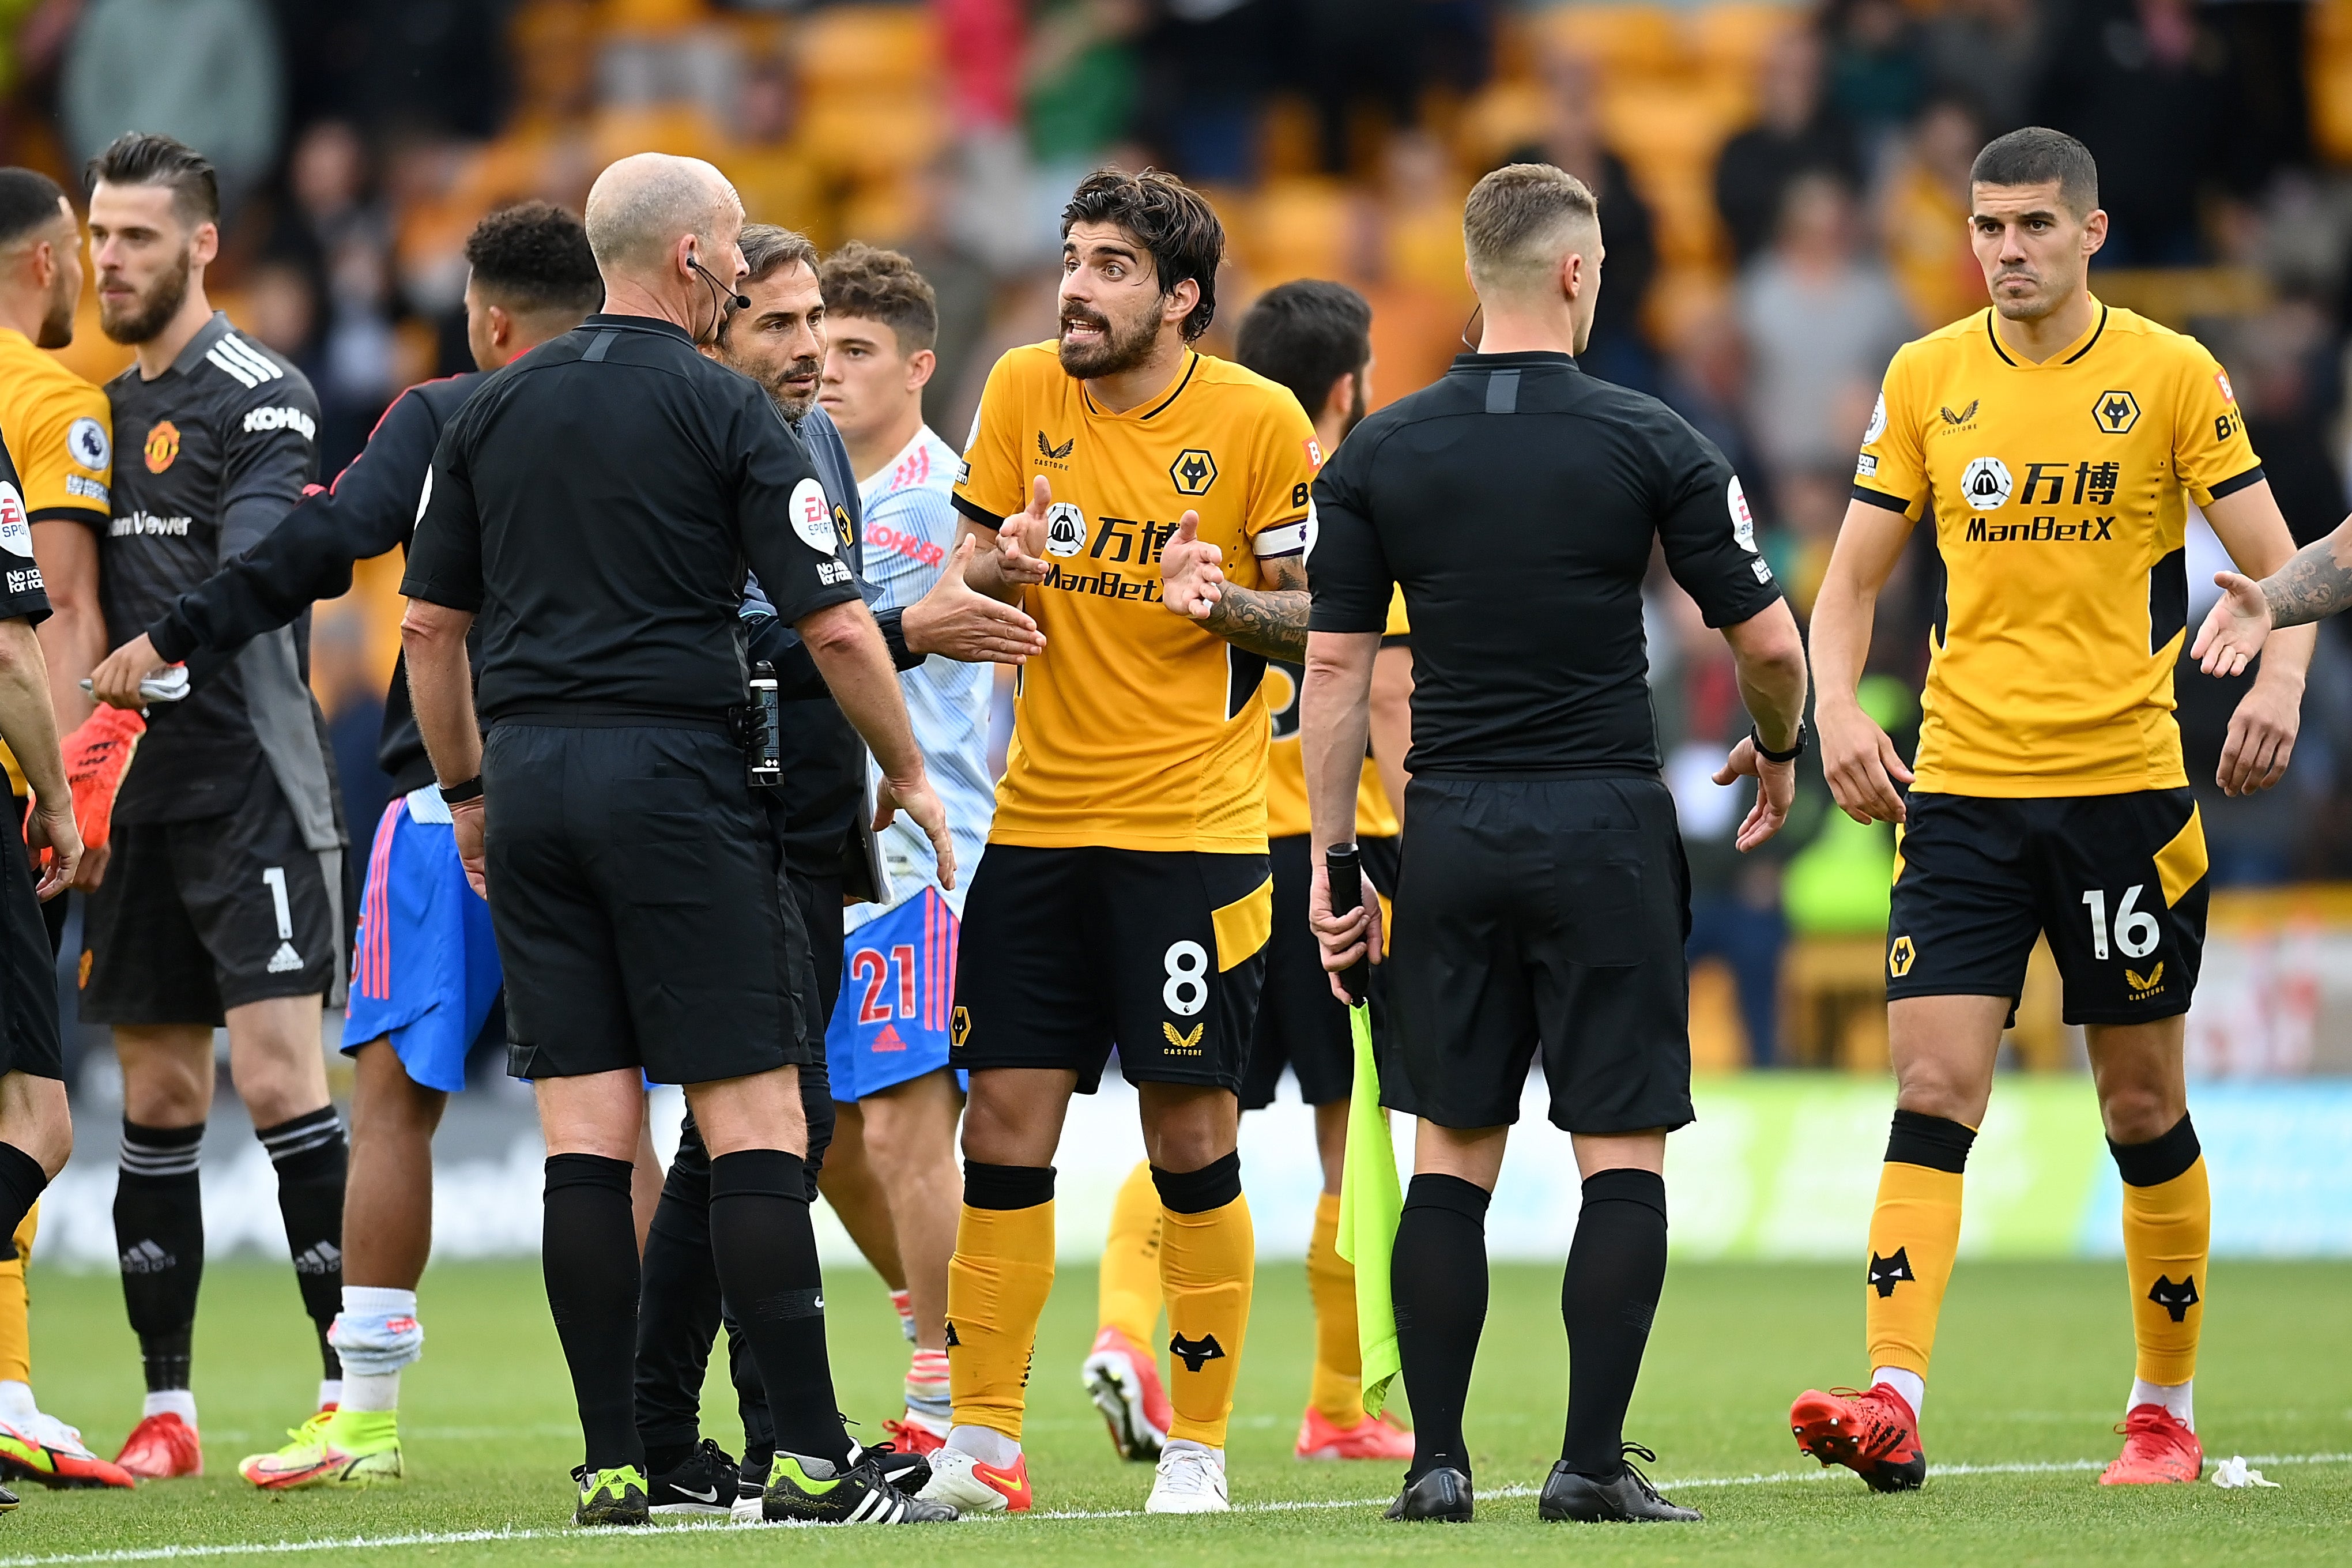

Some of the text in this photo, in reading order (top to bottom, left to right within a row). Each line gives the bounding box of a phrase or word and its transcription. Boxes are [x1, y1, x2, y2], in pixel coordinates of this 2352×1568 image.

[1942, 424, 1977, 436] CASTORE
[1034, 458, 1069, 471] CASTORE
[2020, 462, 2120, 506] 万博
[805, 497, 830, 522] EA
[1966, 517, 2116, 542] ManBetX
[864, 522, 944, 568] KOHLER
[6, 570, 25, 583] No
[816, 562, 834, 575] No
[8, 581, 27, 594] for
[263, 866, 293, 939] 1
[2082, 884, 2160, 960] 16
[851, 944, 916, 1026] 21
[1163, 940, 1208, 1016] 8
[2129, 985, 2165, 1001] CASTORE
[1164, 1048, 1202, 1056] CASTORE
